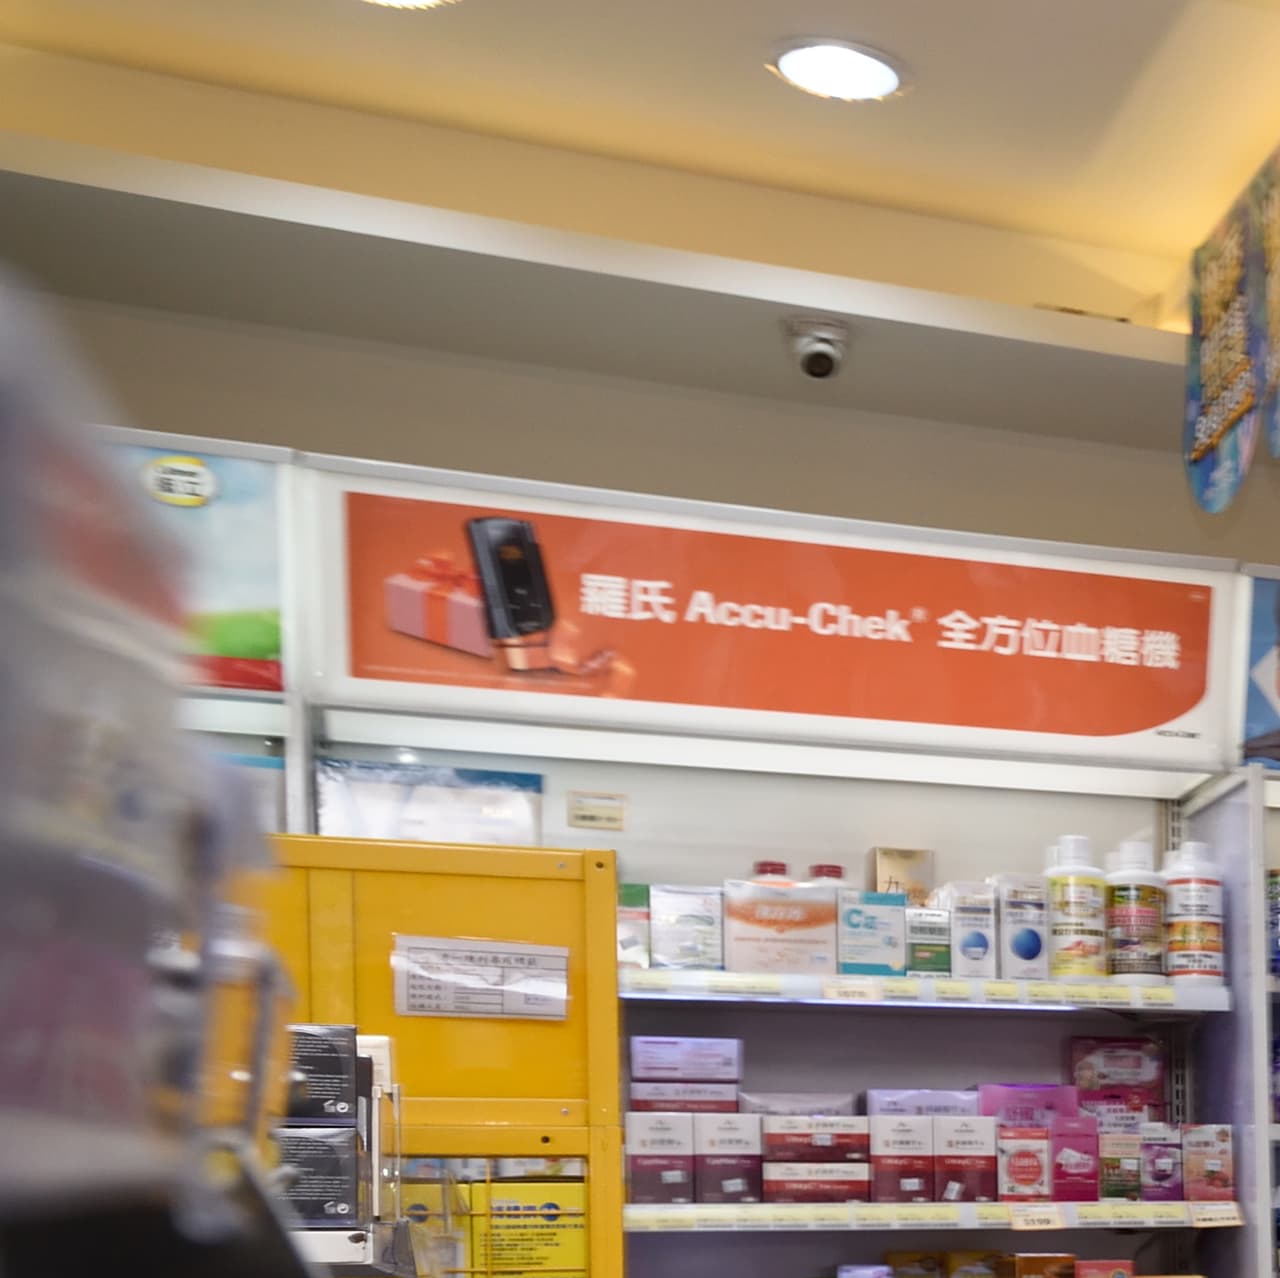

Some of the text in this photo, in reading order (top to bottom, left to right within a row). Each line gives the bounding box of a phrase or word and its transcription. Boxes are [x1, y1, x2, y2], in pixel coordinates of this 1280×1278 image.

[579, 573, 679, 625] 羅氏
[937, 608, 1183, 671] 全方位血糖機
